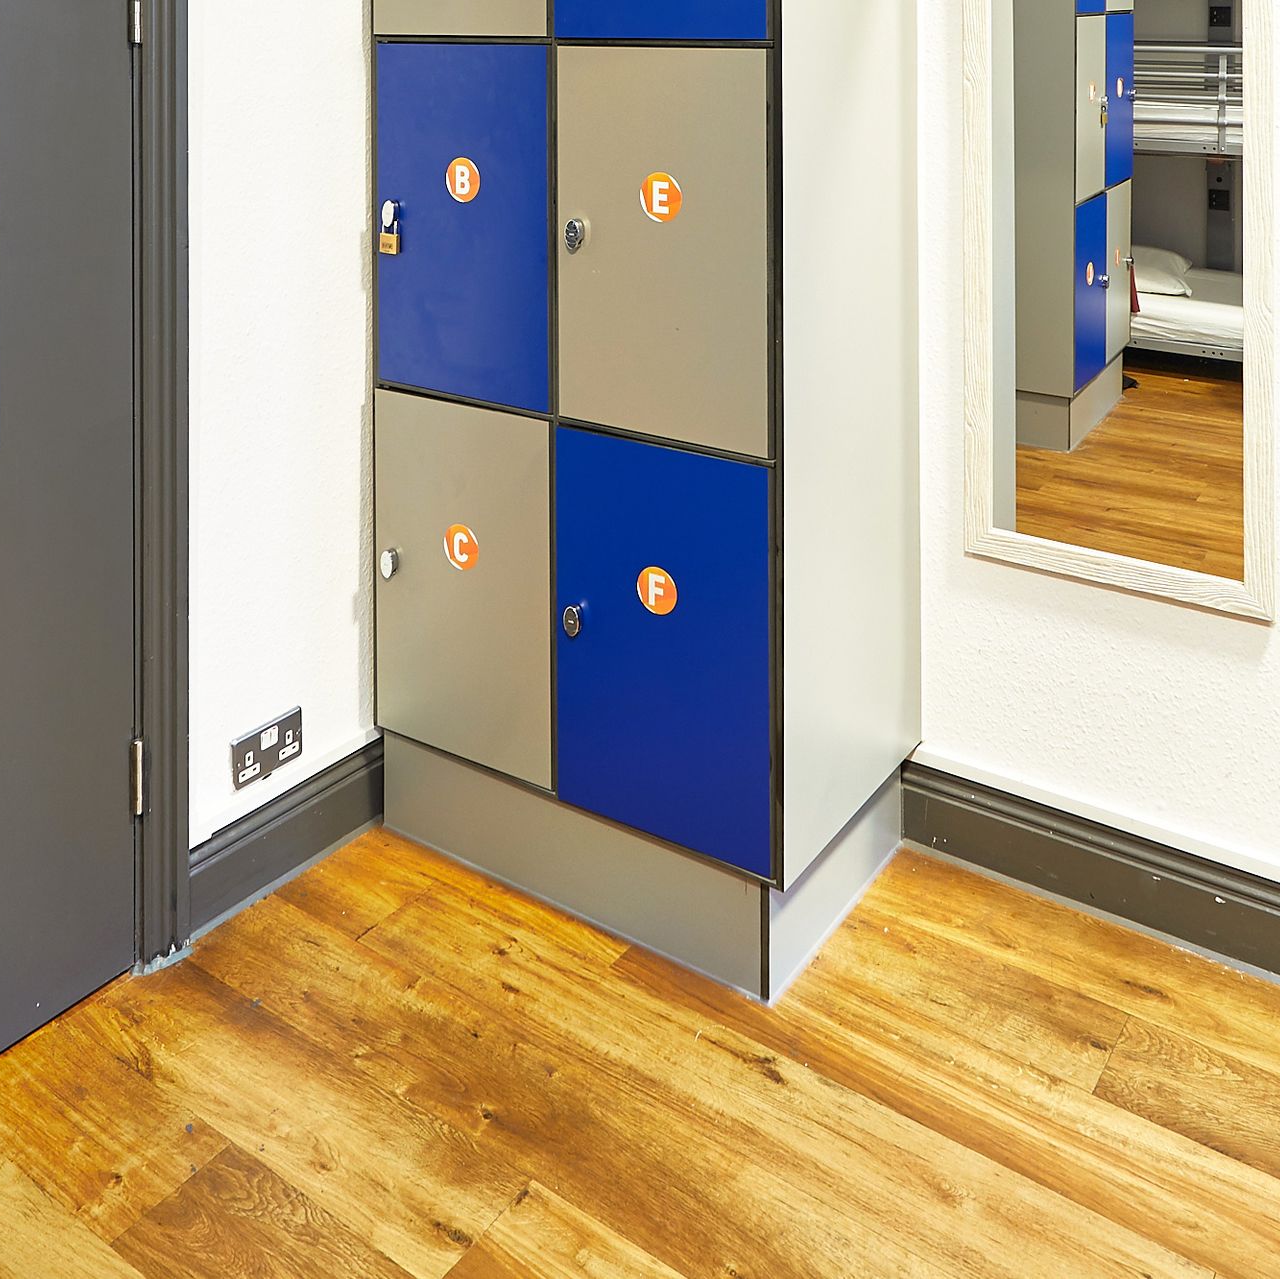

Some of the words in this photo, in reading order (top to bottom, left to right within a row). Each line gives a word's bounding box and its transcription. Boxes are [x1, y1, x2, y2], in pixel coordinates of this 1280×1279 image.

[455, 165, 470, 195] B
[652, 181, 669, 214] E
[453, 532, 468, 562] C
[648, 573, 665, 606] F
